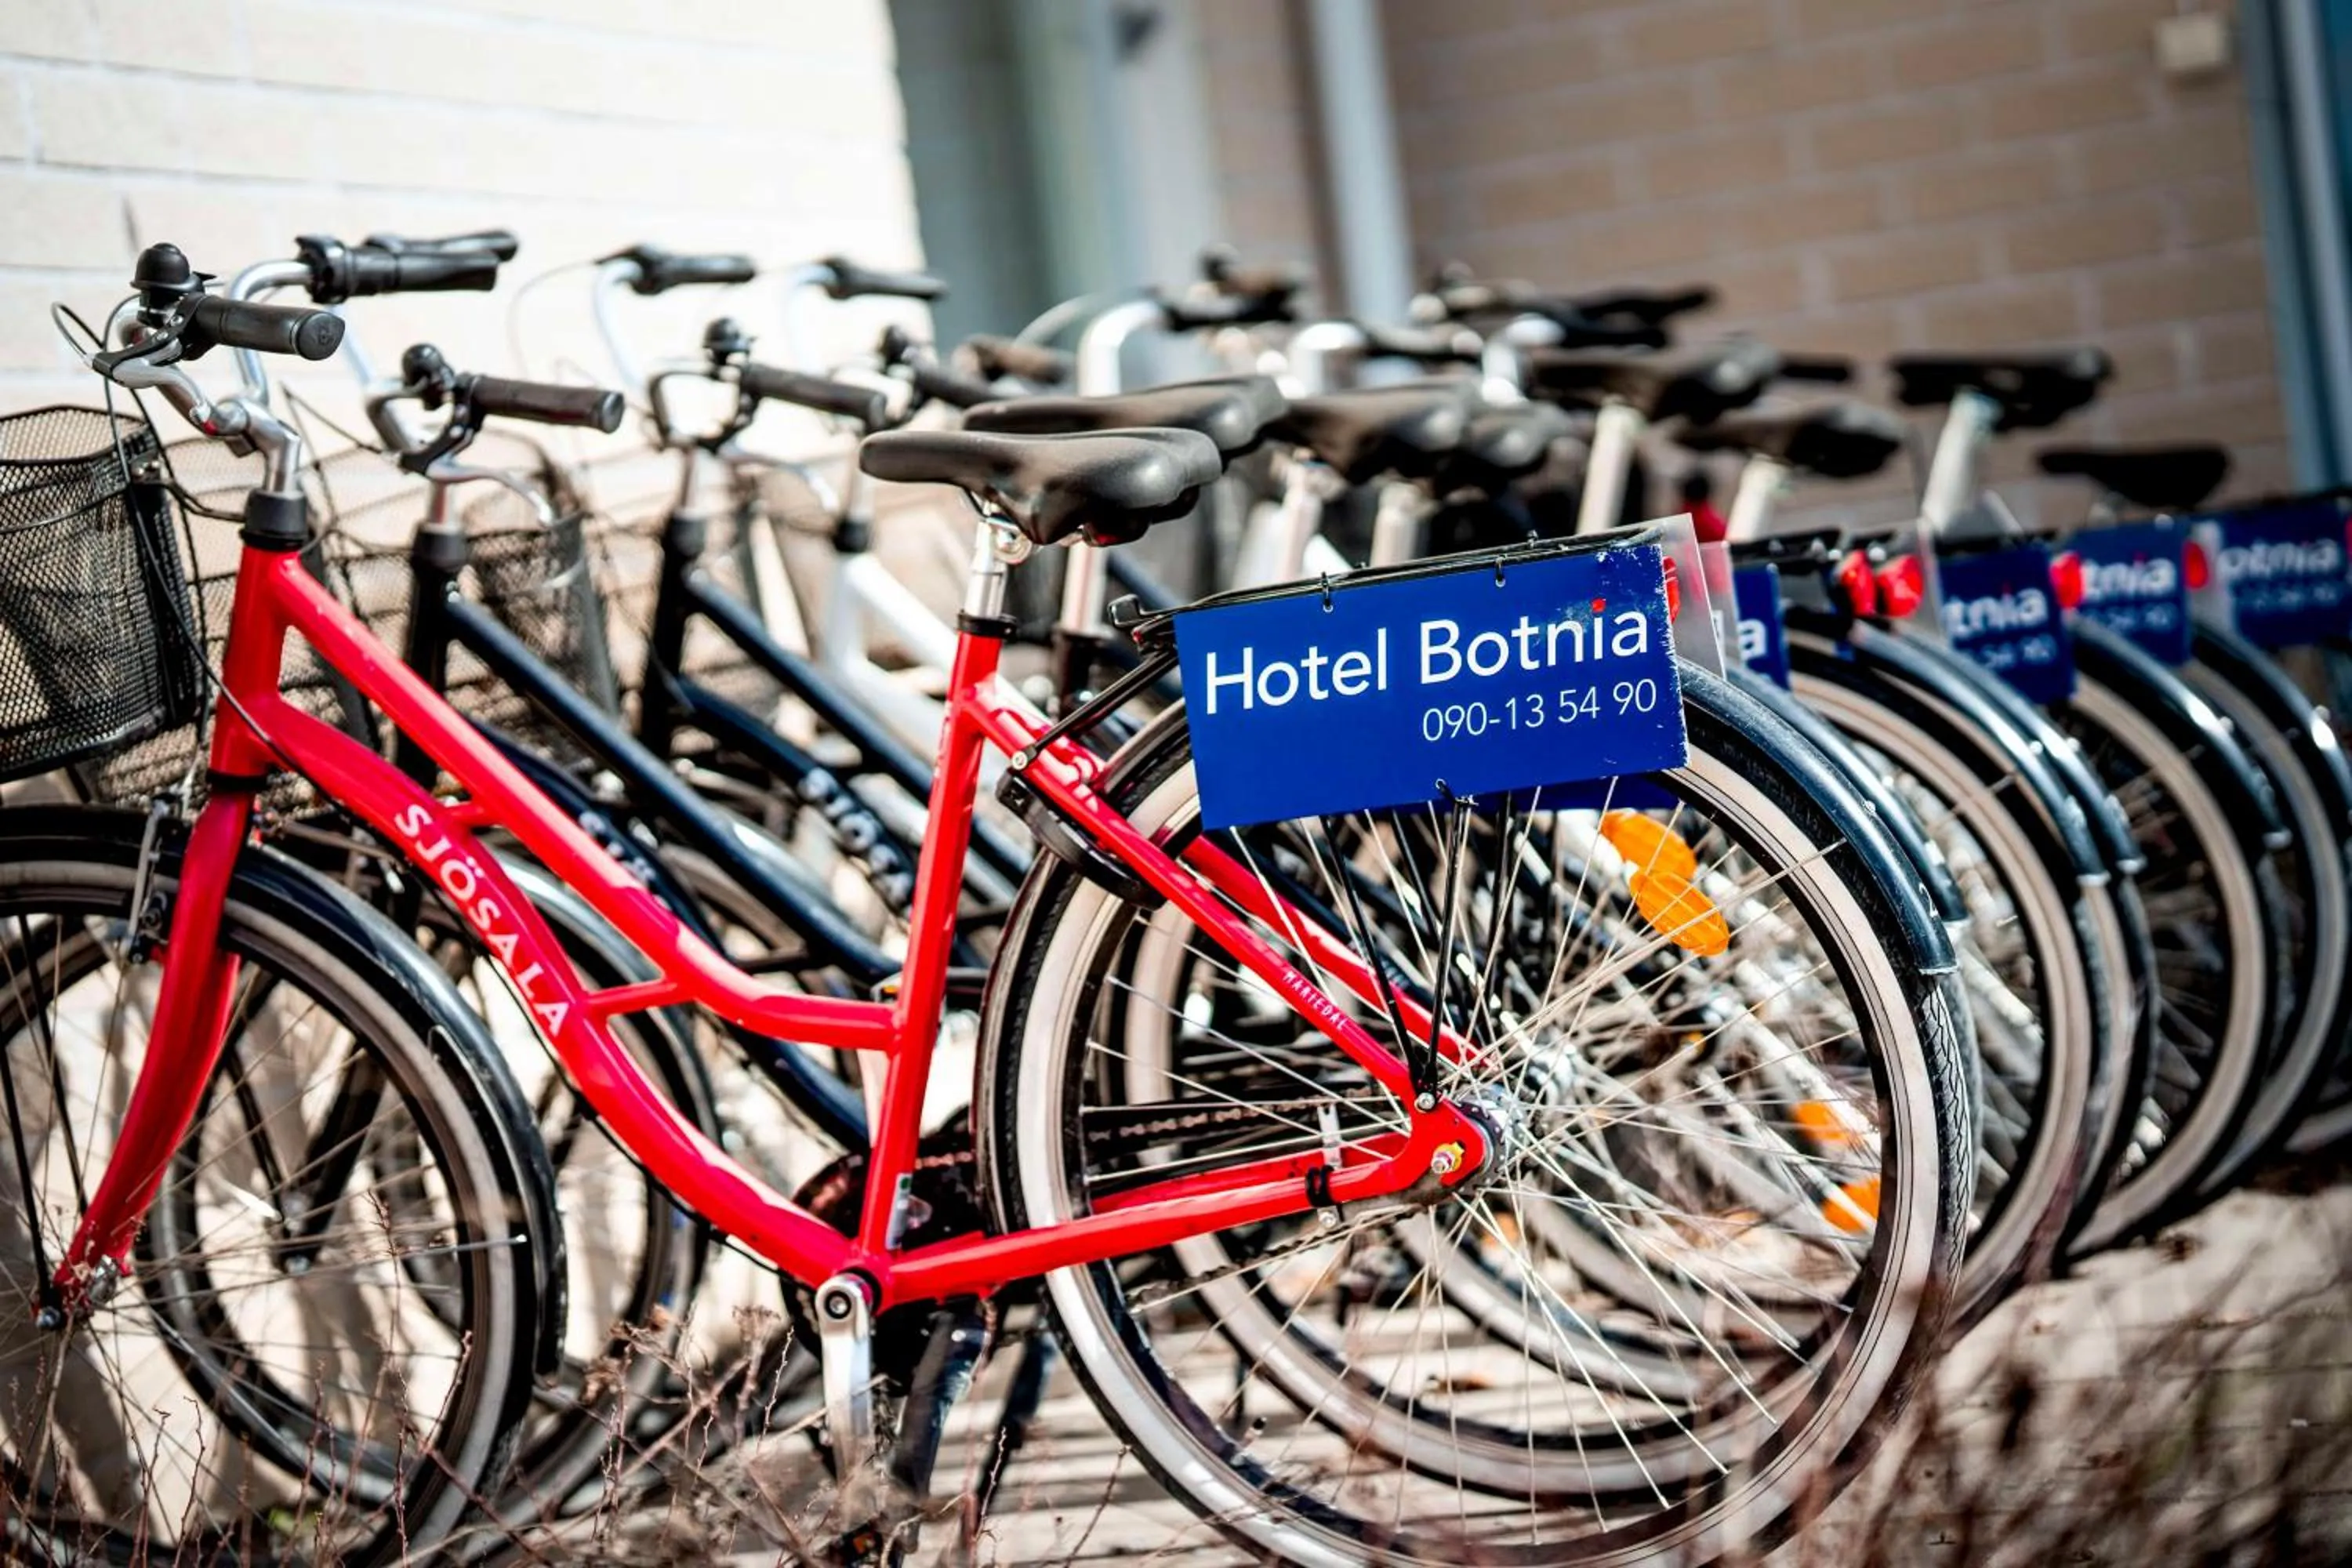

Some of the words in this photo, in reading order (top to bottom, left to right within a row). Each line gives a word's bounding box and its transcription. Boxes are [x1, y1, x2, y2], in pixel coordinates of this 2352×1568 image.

[2080, 551, 2177, 603] tnia
[2217, 537, 2340, 579] otnia
[1943, 582, 2049, 638] tnia
[1206, 627, 1387, 714] Hotel
[1420, 598, 1647, 684] Botnia
[1422, 694, 1544, 741] 090-13
[1559, 686, 1600, 723] 54
[1613, 678, 1656, 715] 90
[797, 767, 914, 919] SJÖSA
[394, 804, 570, 1036] SJÖSALA
[1283, 969, 1347, 1030] MARIEDAL
